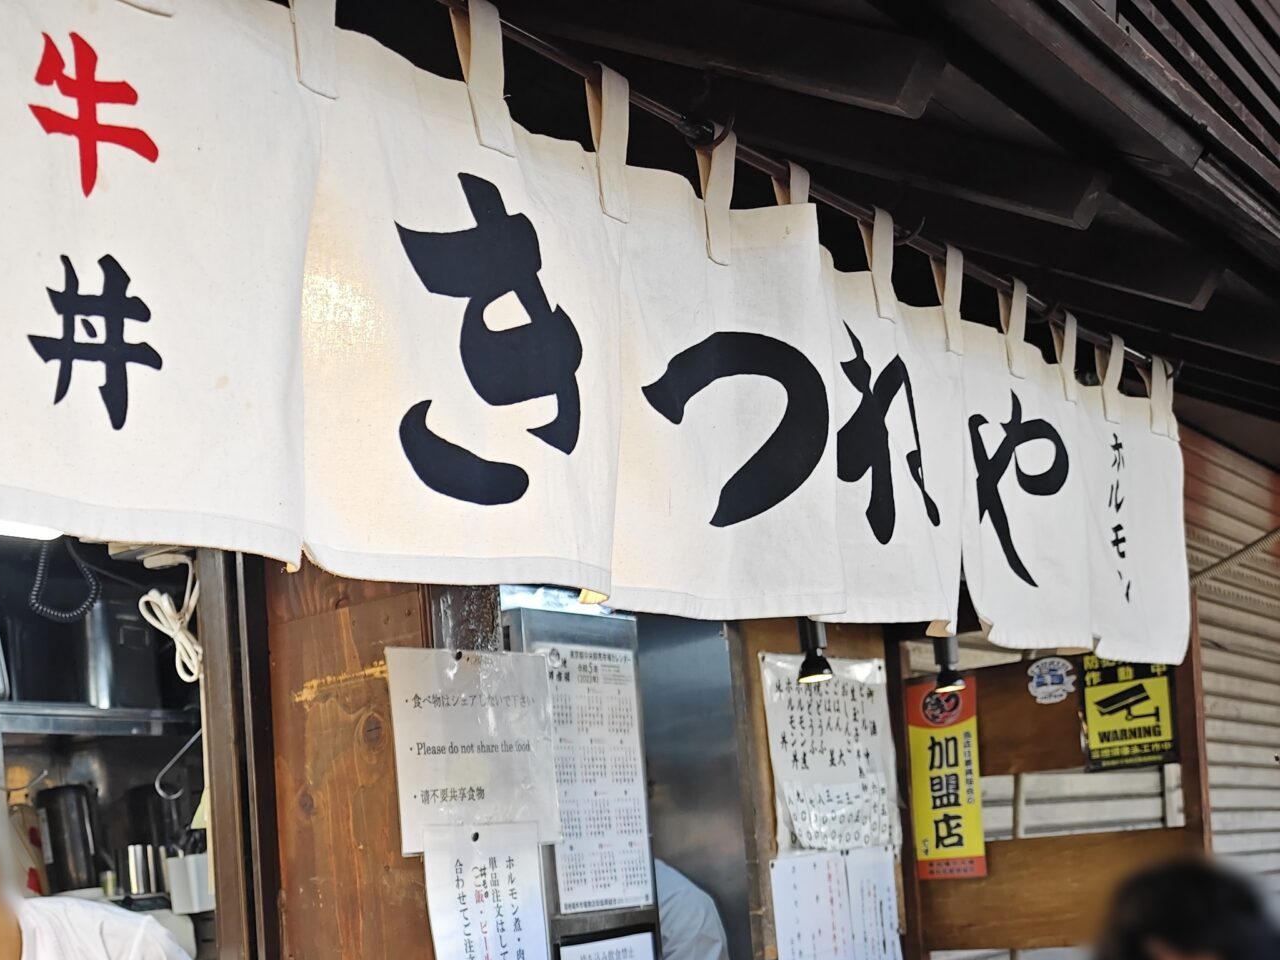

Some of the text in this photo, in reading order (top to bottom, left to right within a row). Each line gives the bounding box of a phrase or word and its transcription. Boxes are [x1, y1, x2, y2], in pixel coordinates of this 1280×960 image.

[27, 31, 163, 431] 牛丼
[1107, 432, 1132, 603] ホルモン
[416, 741, 446, 756] Please
[448, 742, 459, 754] do
[461, 743, 475, 755] not
[477, 741, 499, 754] share
[501, 741, 518, 753] the
[1097, 724, 1162, 744] WARNING
[420, 786, 486, 805] 请不要共享食物
[927, 735, 964, 850] 加盟店
